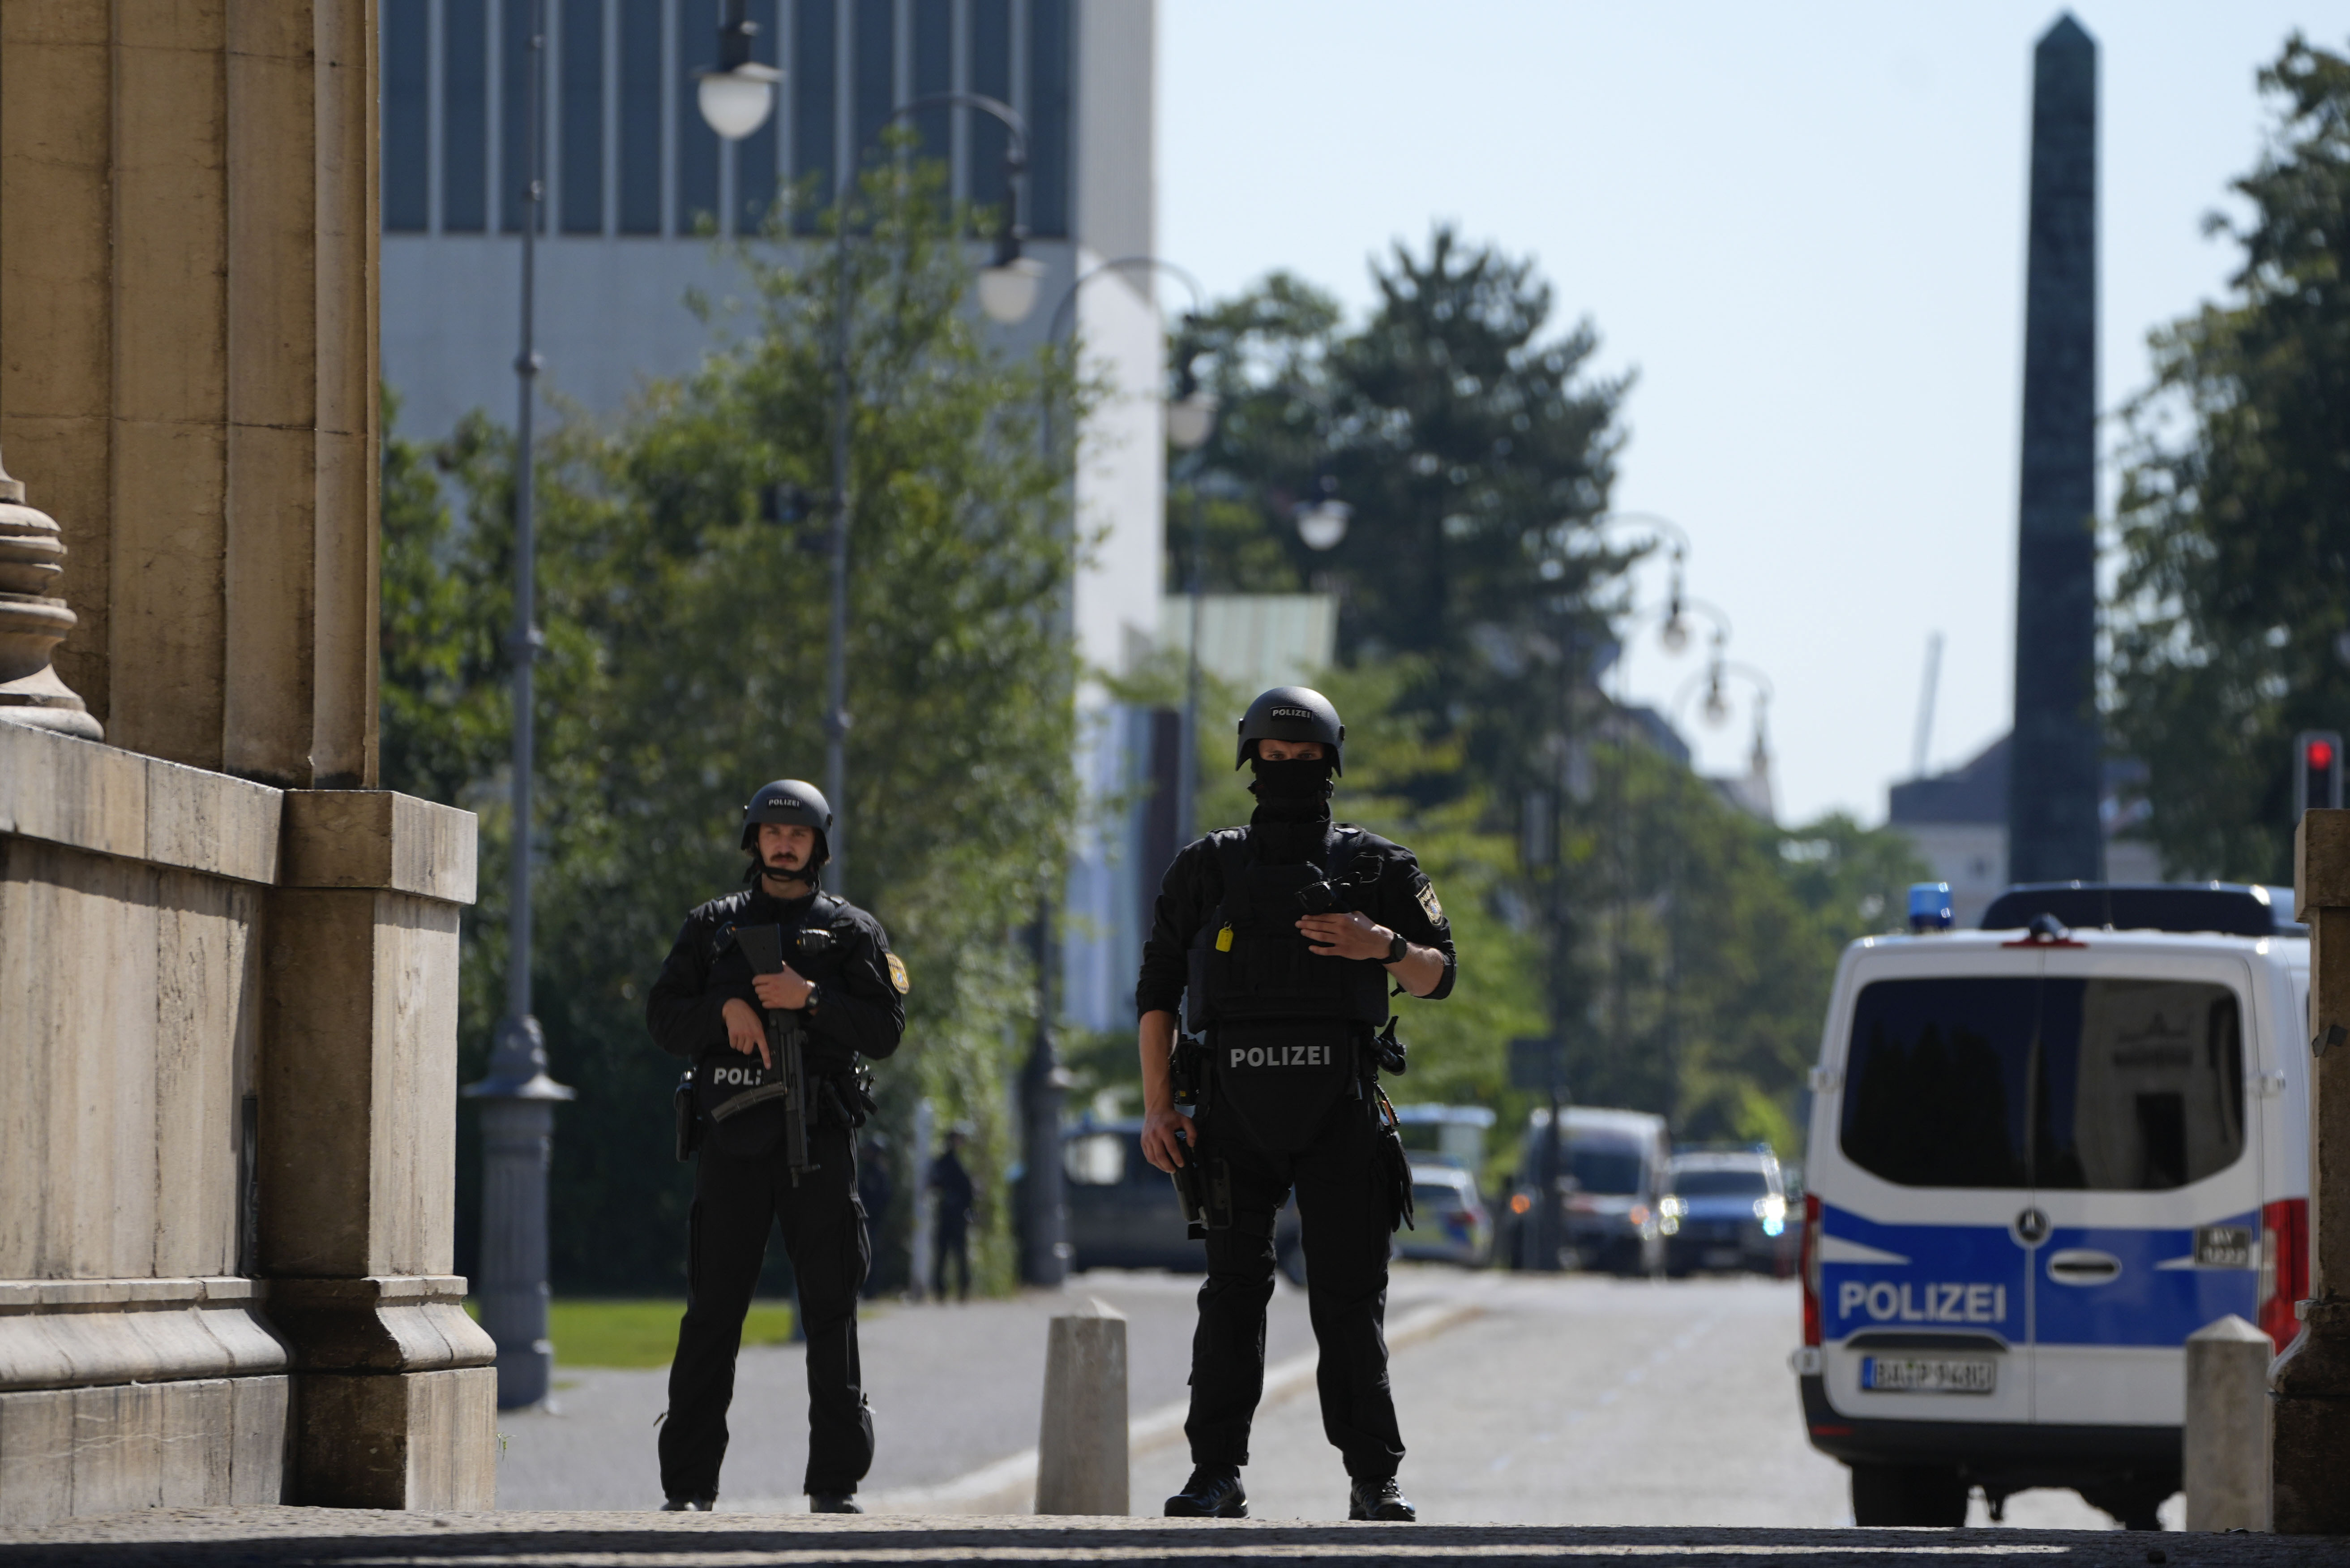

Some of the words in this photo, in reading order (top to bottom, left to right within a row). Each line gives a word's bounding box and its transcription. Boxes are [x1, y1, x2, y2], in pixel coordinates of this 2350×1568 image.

[1272, 709, 1310, 718] POLIZEI
[768, 798, 799, 807] POLIZEI
[1230, 1046, 1330, 1067] POLIZEI
[714, 1067, 764, 1085] POLI
[1838, 1281, 2006, 1322] POLIZEI
